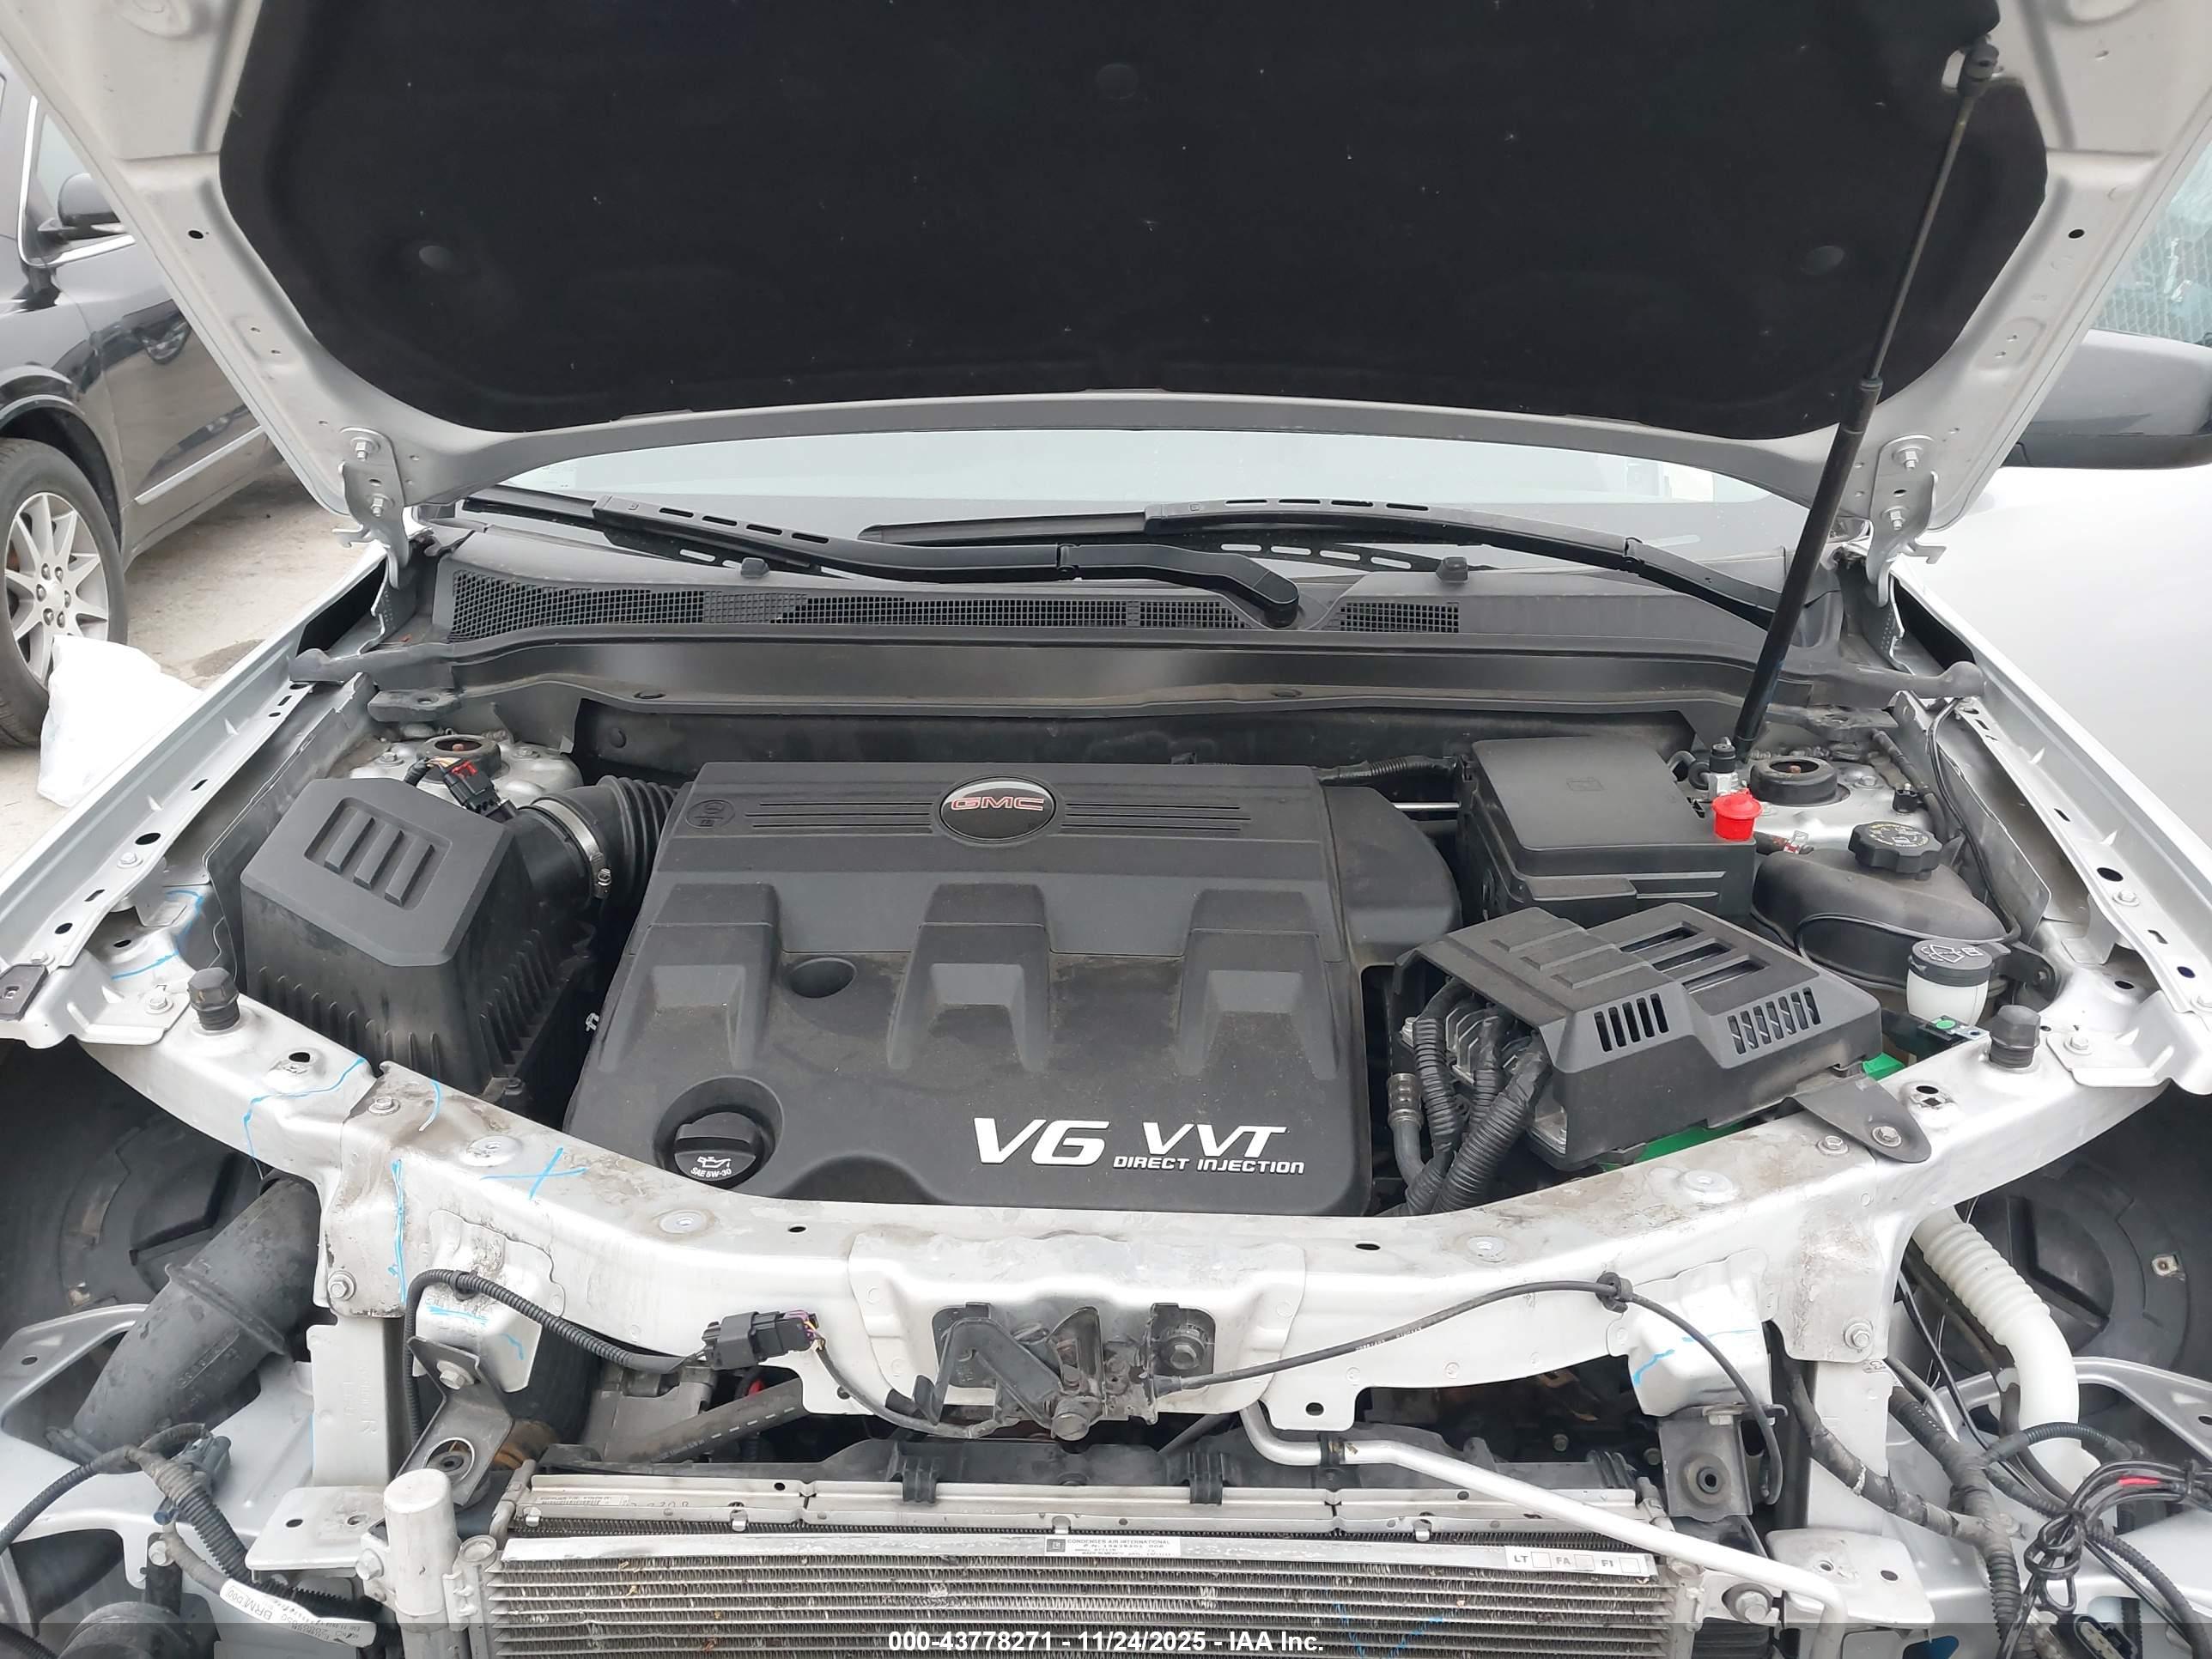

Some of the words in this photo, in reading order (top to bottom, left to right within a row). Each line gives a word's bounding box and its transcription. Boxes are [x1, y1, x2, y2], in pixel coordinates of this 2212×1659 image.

[951, 796, 1045, 811] GMC
[973, 1117, 1110, 1166] V6
[1142, 1121, 1288, 1158] VVT
[690, 1167, 706, 1176] SAE
[706, 1168, 732, 1177] 5W-30
[1113, 1155, 1189, 1170] DIRECT
[1197, 1158, 1305, 1174] INJECTION
